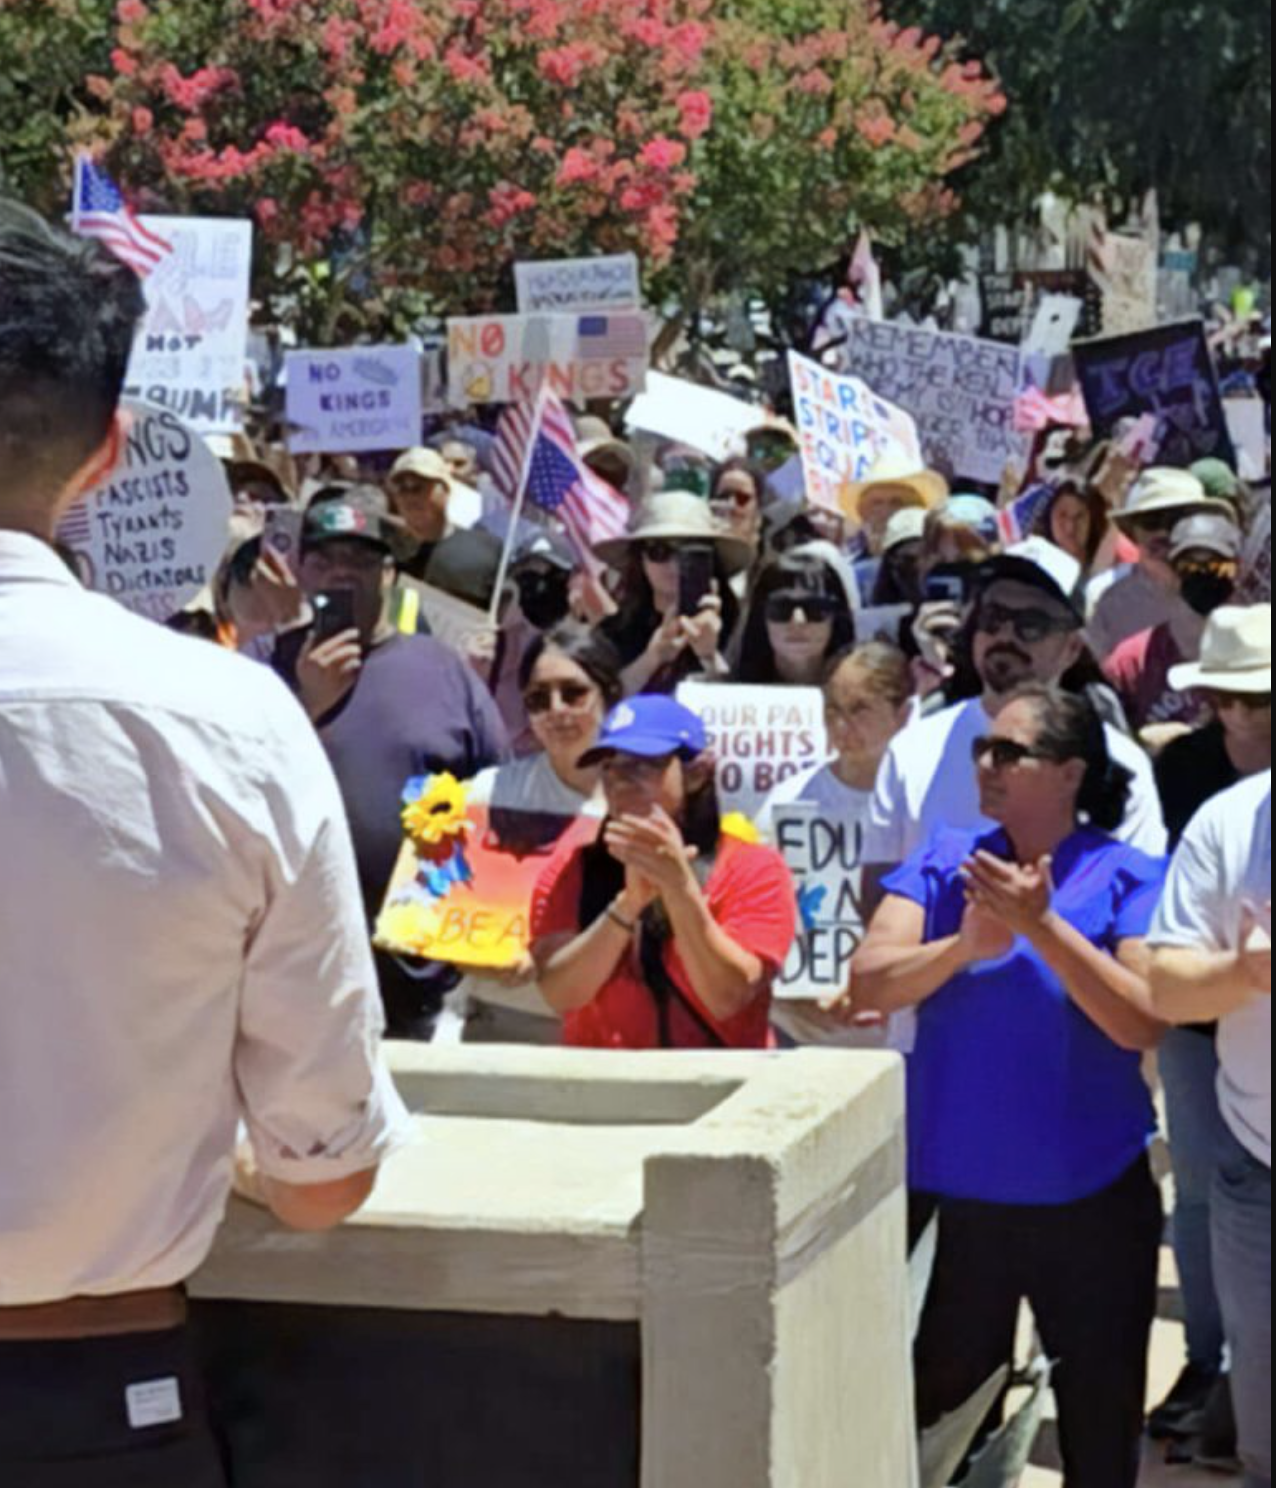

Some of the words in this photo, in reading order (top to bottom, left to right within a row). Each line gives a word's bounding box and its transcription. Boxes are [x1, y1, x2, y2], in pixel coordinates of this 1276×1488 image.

[308, 361, 342, 384] NO
[508, 357, 630, 403] KINGS
[319, 389, 392, 412] KINGS
[126, 410, 191, 468] NGS
[96, 470, 190, 508] FASCISTS
